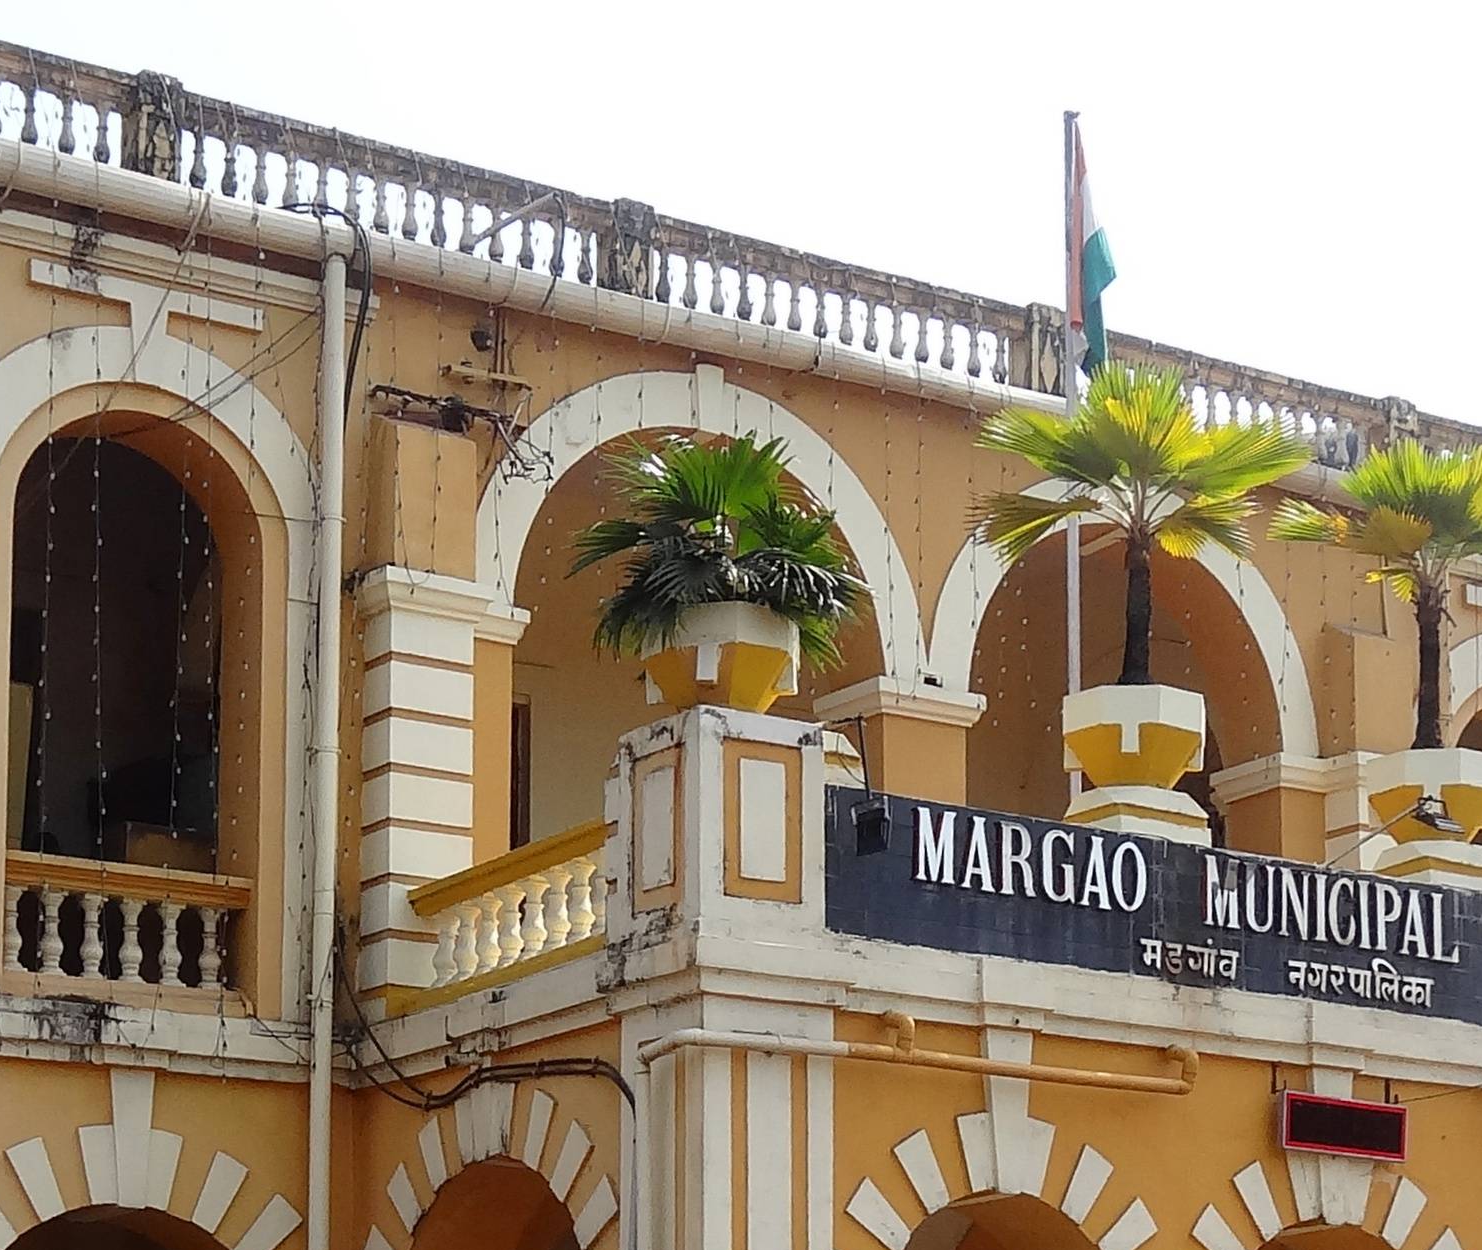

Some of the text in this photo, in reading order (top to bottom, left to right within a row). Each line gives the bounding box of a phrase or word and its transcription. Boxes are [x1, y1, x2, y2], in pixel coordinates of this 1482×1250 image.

[915, 805, 1148, 913] MARGAO
[1204, 853, 1460, 964] MUNICIPAL
[1140, 937, 1435, 1009] मडगांव नगरपालिका
